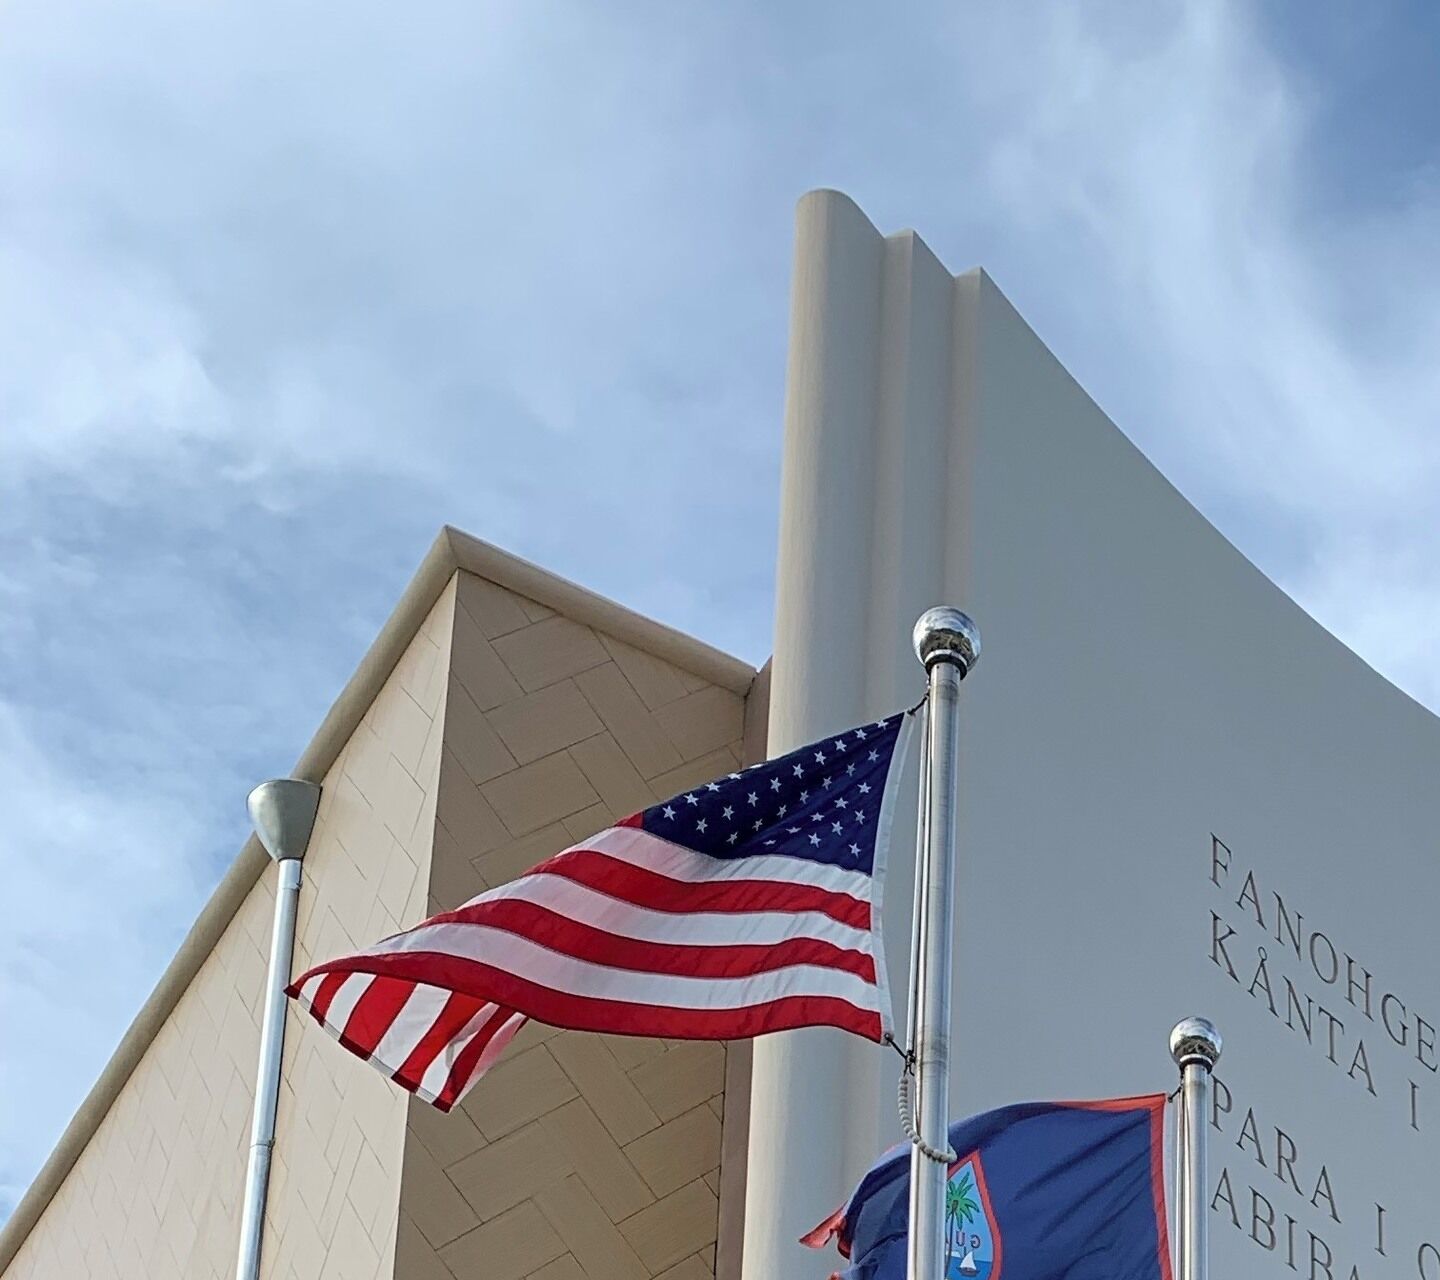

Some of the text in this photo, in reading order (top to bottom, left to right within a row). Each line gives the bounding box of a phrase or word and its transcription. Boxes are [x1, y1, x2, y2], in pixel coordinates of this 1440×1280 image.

[1208, 909, 1377, 1098] KÅNTA
[1407, 1079, 1419, 1132] I
[1209, 832, 1438, 1072] FANOHGE
[1209, 1075, 1342, 1225] PARA
[1374, 1201, 1387, 1258] I
